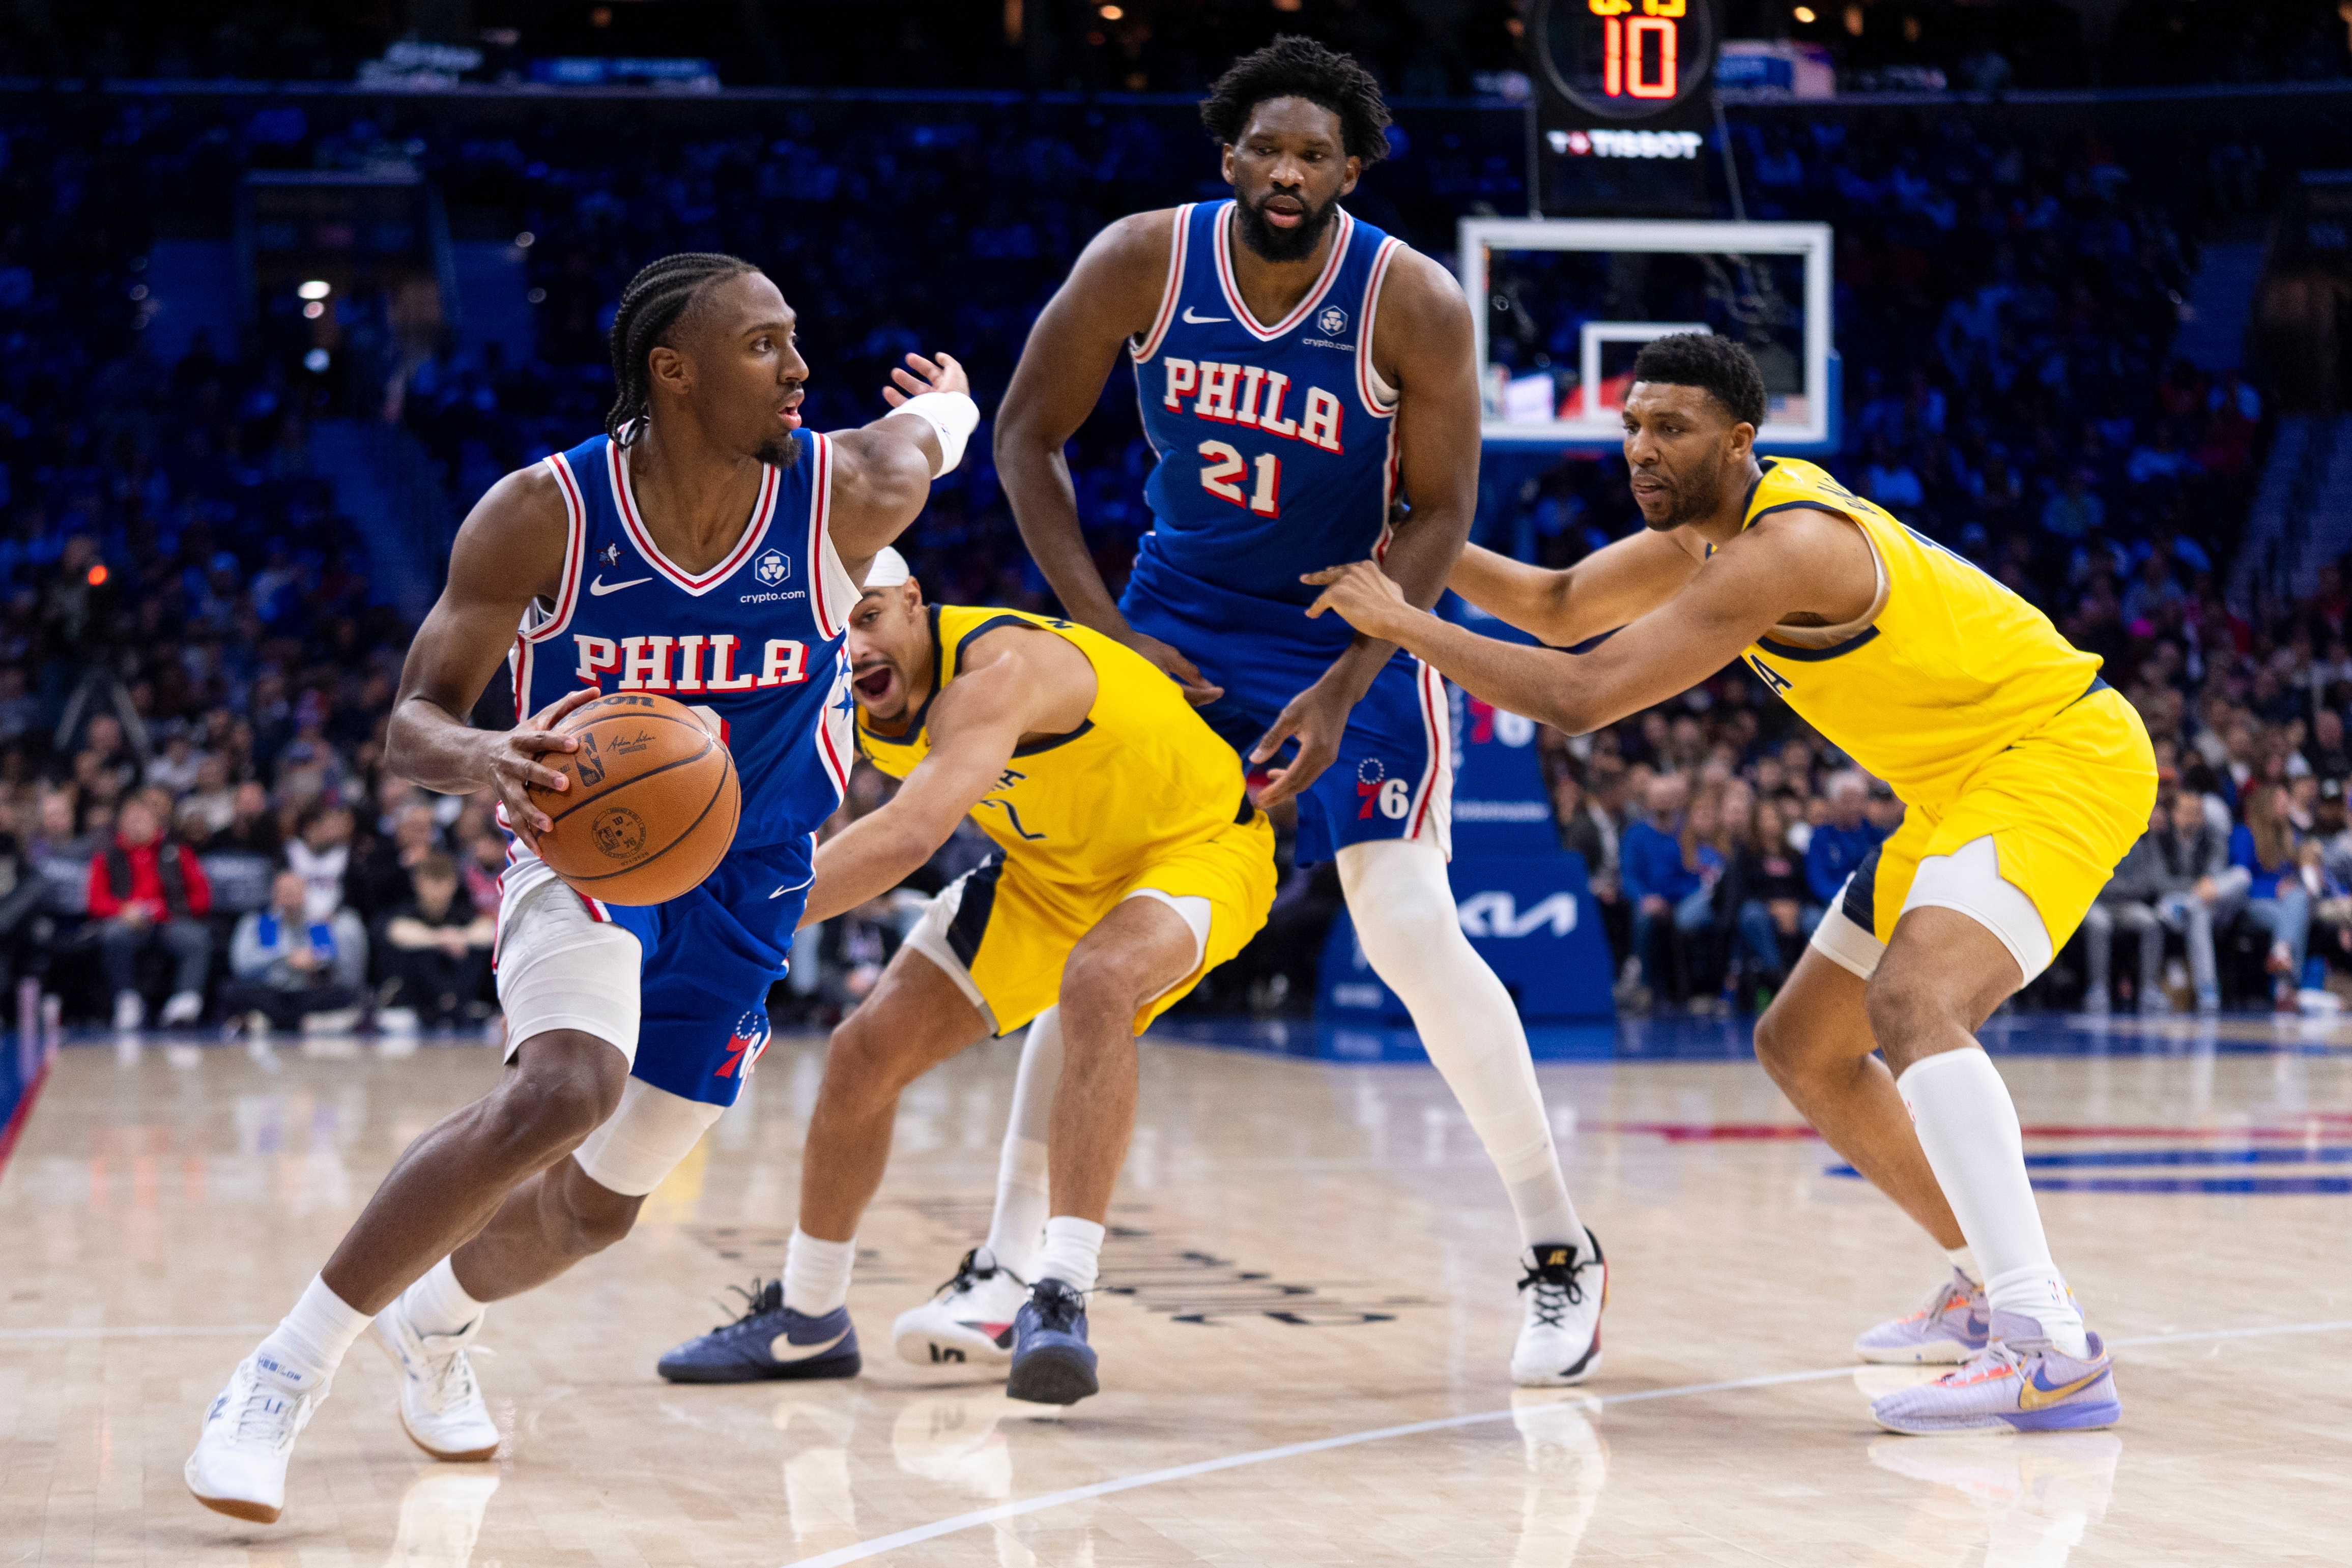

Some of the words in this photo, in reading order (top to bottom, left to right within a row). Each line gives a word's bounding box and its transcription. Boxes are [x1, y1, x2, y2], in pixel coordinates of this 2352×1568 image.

[1603, 15, 1677, 98] 10
[1588, 129, 1703, 159] TISSOT
[1302, 338, 1355, 352] crypto.com
[1163, 356, 1344, 456] PHILA
[1197, 439, 1282, 519] 21
[739, 590, 806, 604] crypto.com
[573, 634, 810, 695] PHILA
[1357, 777, 1410, 821] 76
